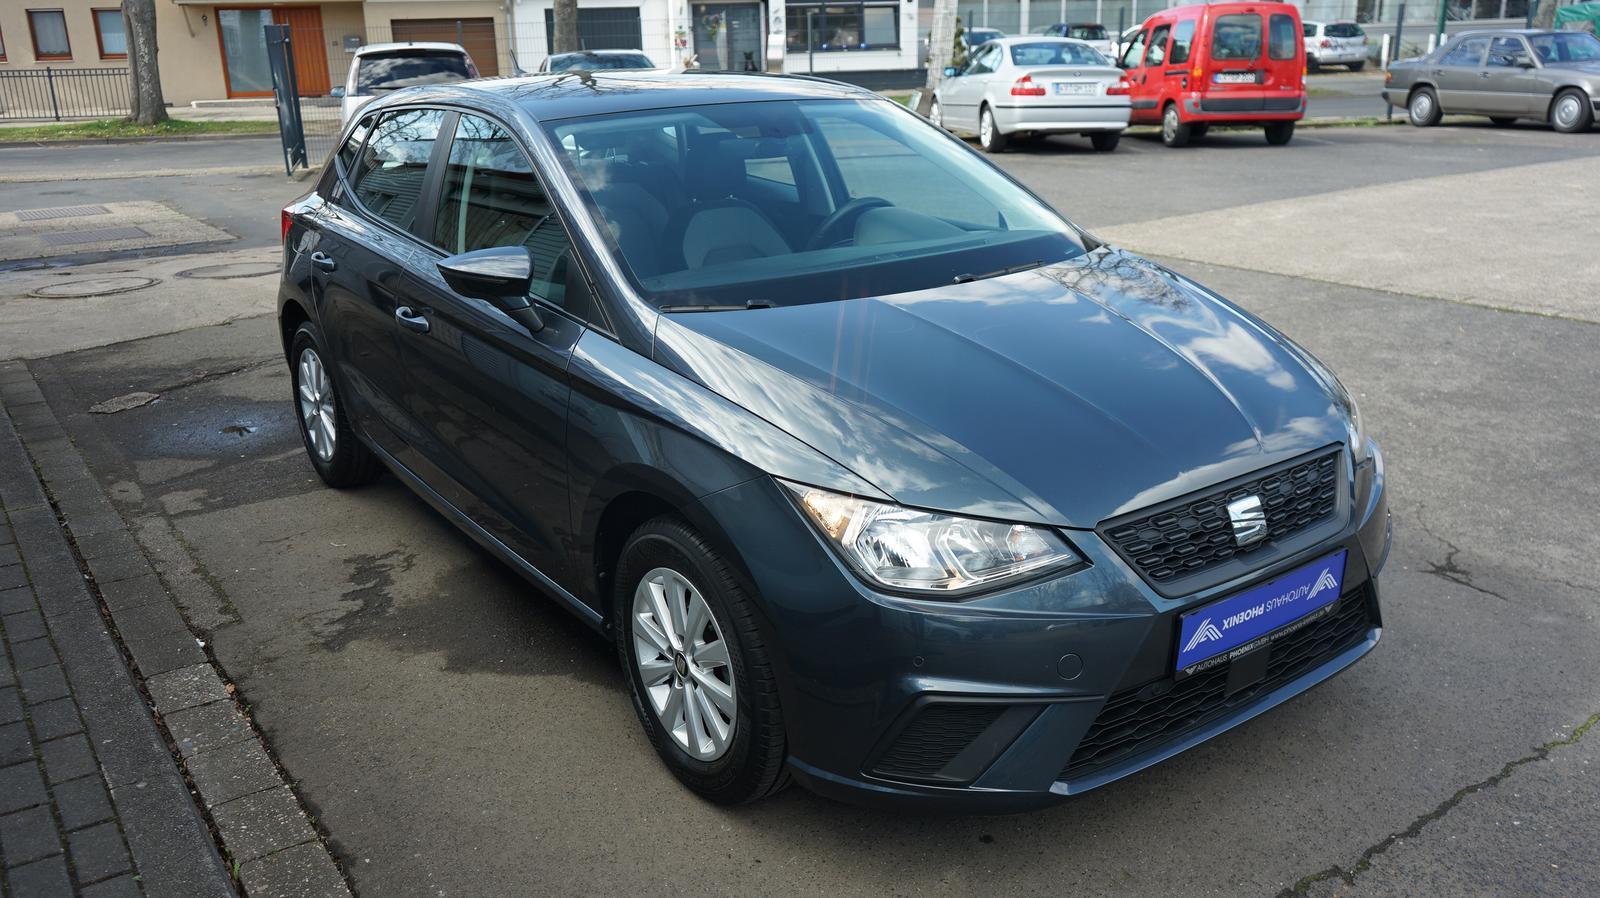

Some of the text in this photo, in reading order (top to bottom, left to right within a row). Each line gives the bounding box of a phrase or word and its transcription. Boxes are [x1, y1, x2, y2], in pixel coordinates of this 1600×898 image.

[1266, 583, 1311, 612] AUTOHAUS
[1222, 603, 1265, 630] PHOENIX
[1196, 653, 1228, 672] AUTOHAUS
